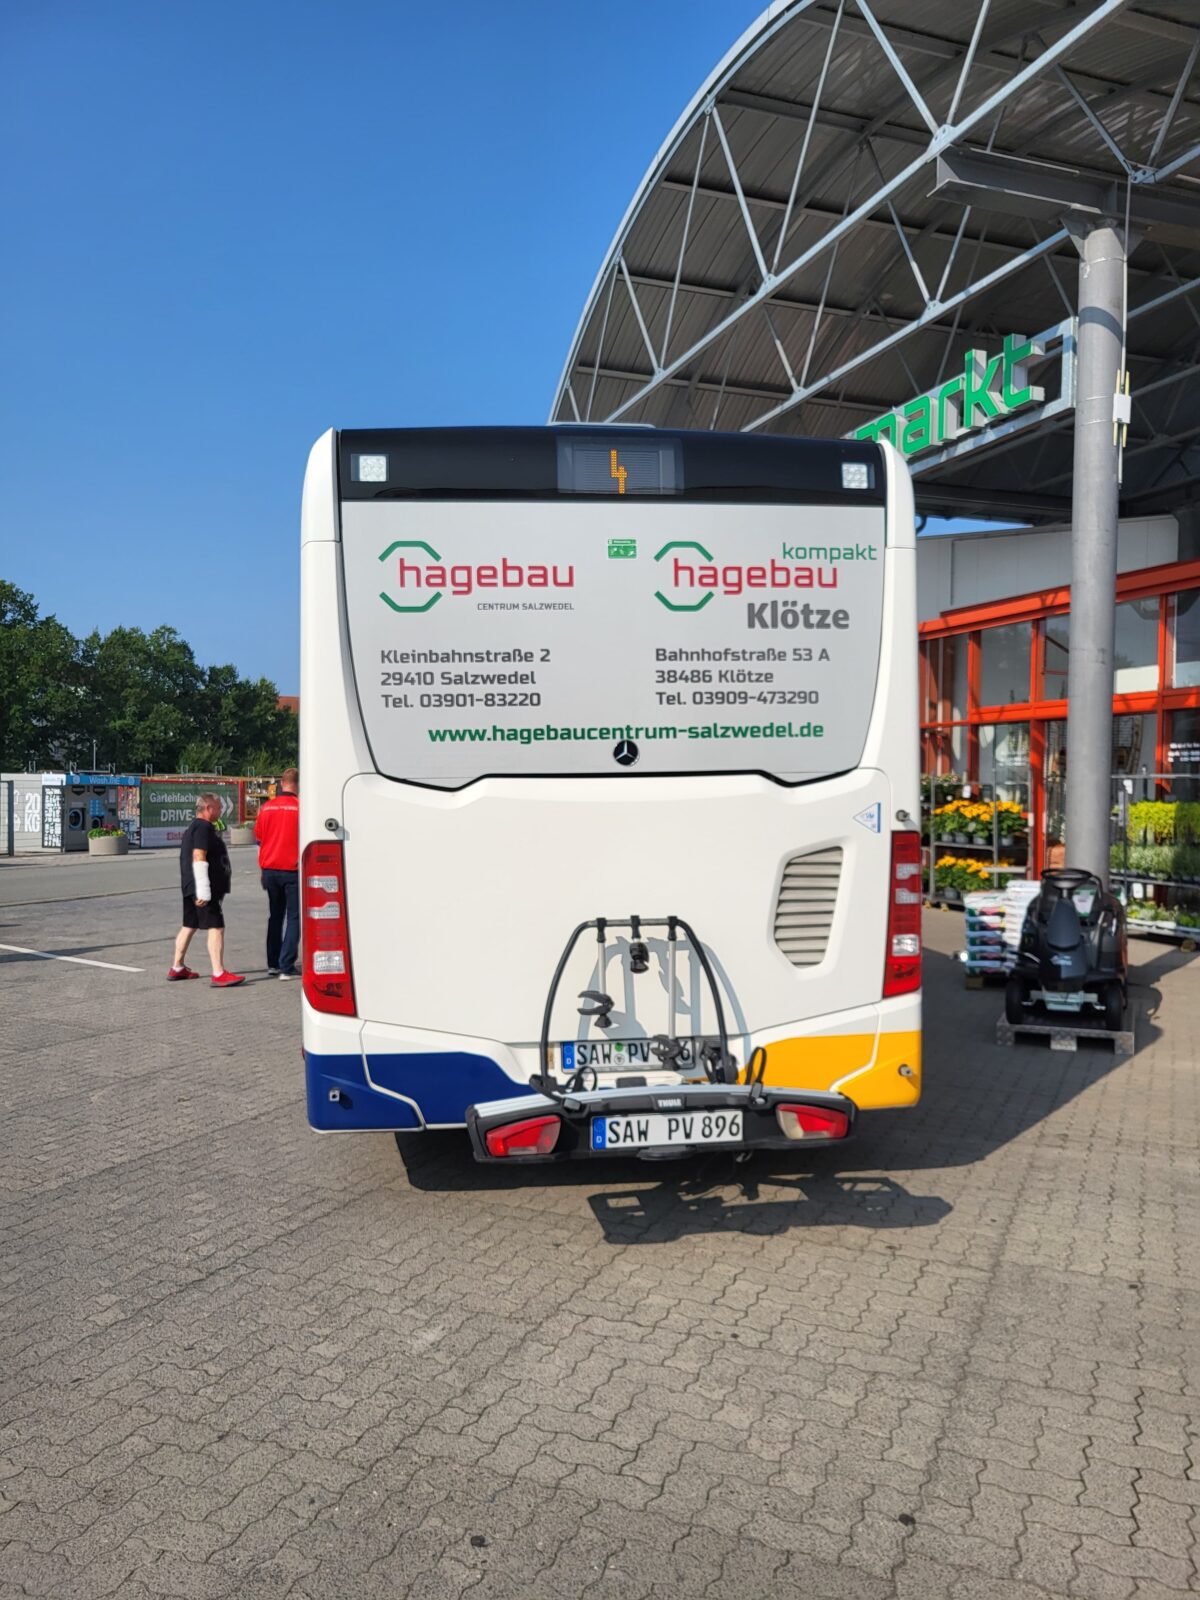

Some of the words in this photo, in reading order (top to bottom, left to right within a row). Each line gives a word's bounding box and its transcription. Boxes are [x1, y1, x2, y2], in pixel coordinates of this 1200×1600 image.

[610, 448, 628, 494] 4
[782, 542, 878, 564] kompakt
[399, 557, 575, 596] hagebau
[673, 557, 838, 595] hagebau
[477, 602, 520, 611] CENTRUM
[521, 602, 575, 611] SALZWEDEL
[747, 600, 850, 630] Klötze
[380, 649, 534, 664] Kleinbahnstraße
[539, 648, 551, 663] 2
[655, 648, 787, 662] Bahnhofstraße
[791, 648, 813, 662] 53
[818, 648, 831, 662] A
[380, 671, 435, 686] 29410
[440, 670, 536, 686] Salzwedel
[655, 669, 713, 683] 38486
[718, 669, 774, 683] Klötze
[381, 694, 414, 708] Tel.
[419, 692, 542, 708] 03901-83220
[655, 691, 687, 705] Tel.
[692, 690, 819, 705] 03909-473290
[428, 721, 824, 745] www.hagebaucentrum-salzwedel.de
[25, 792, 41, 813] 20
[24, 812, 41, 833] KG
[160, 809, 196, 822] DRIVE-
[576, 1043, 612, 1066] SAW
[628, 1042, 650, 1063] PV
[608, 1118, 650, 1144] SAW
[667, 1116, 694, 1141] PV
[701, 1113, 741, 1140] 896
